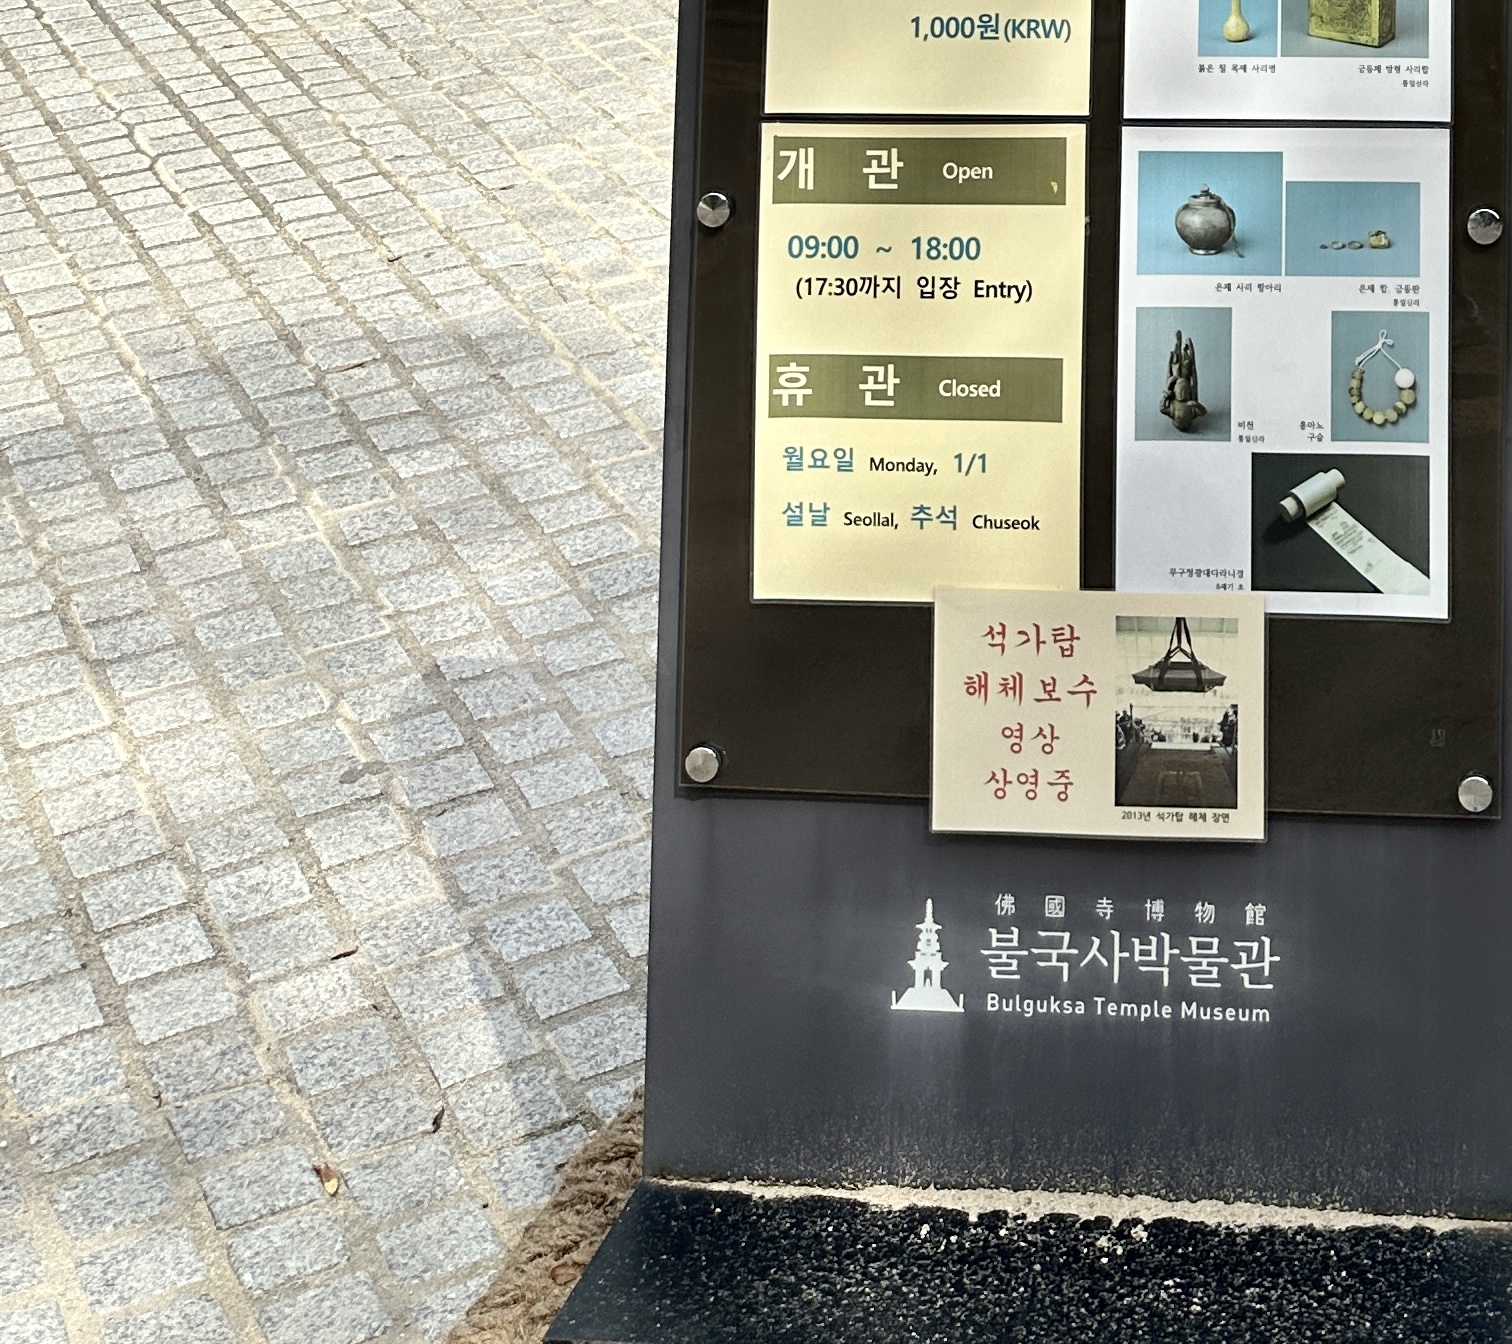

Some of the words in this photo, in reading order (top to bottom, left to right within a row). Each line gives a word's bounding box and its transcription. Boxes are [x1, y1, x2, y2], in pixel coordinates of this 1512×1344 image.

[911, 13, 1071, 42] 1,000원(KRW)
[778, 148, 814, 190] 개
[863, 148, 903, 189] 관
[943, 163, 992, 182] Open
[788, 235, 859, 259] 09:00
[912, 236, 980, 260] 18:00
[796, 275, 900, 299] (17:30까지
[917, 276, 961, 299] 입장
[974, 280, 1032, 304] Entry)
[773, 362, 812, 406] 휴
[859, 364, 900, 406] 관
[939, 379, 1000, 397] Closed
[783, 447, 853, 472] 월요일
[870, 457, 937, 476] Monday,
[954, 453, 986, 476] 1/1
[782, 502, 830, 527] 설날
[844, 512, 898, 529] Seollal,
[911, 505, 956, 530] 추석
[973, 515, 1040, 530] Chuseok
[983, 622, 1080, 658] 석가탑
[1002, 722, 1060, 755] 영상
[985, 768, 1073, 802] 상영중
[1121, 810, 1151, 822] 2013년
[1155, 811, 1184, 823] 석가탑
[994, 894, 1267, 925] 佛國寺博物館
[980, 924, 1280, 989] 불국사박물관
[987, 993, 1084, 1017] Bulguksa
[1094, 997, 1172, 1021] Temple
[1181, 1001, 1269, 1022] Museum
